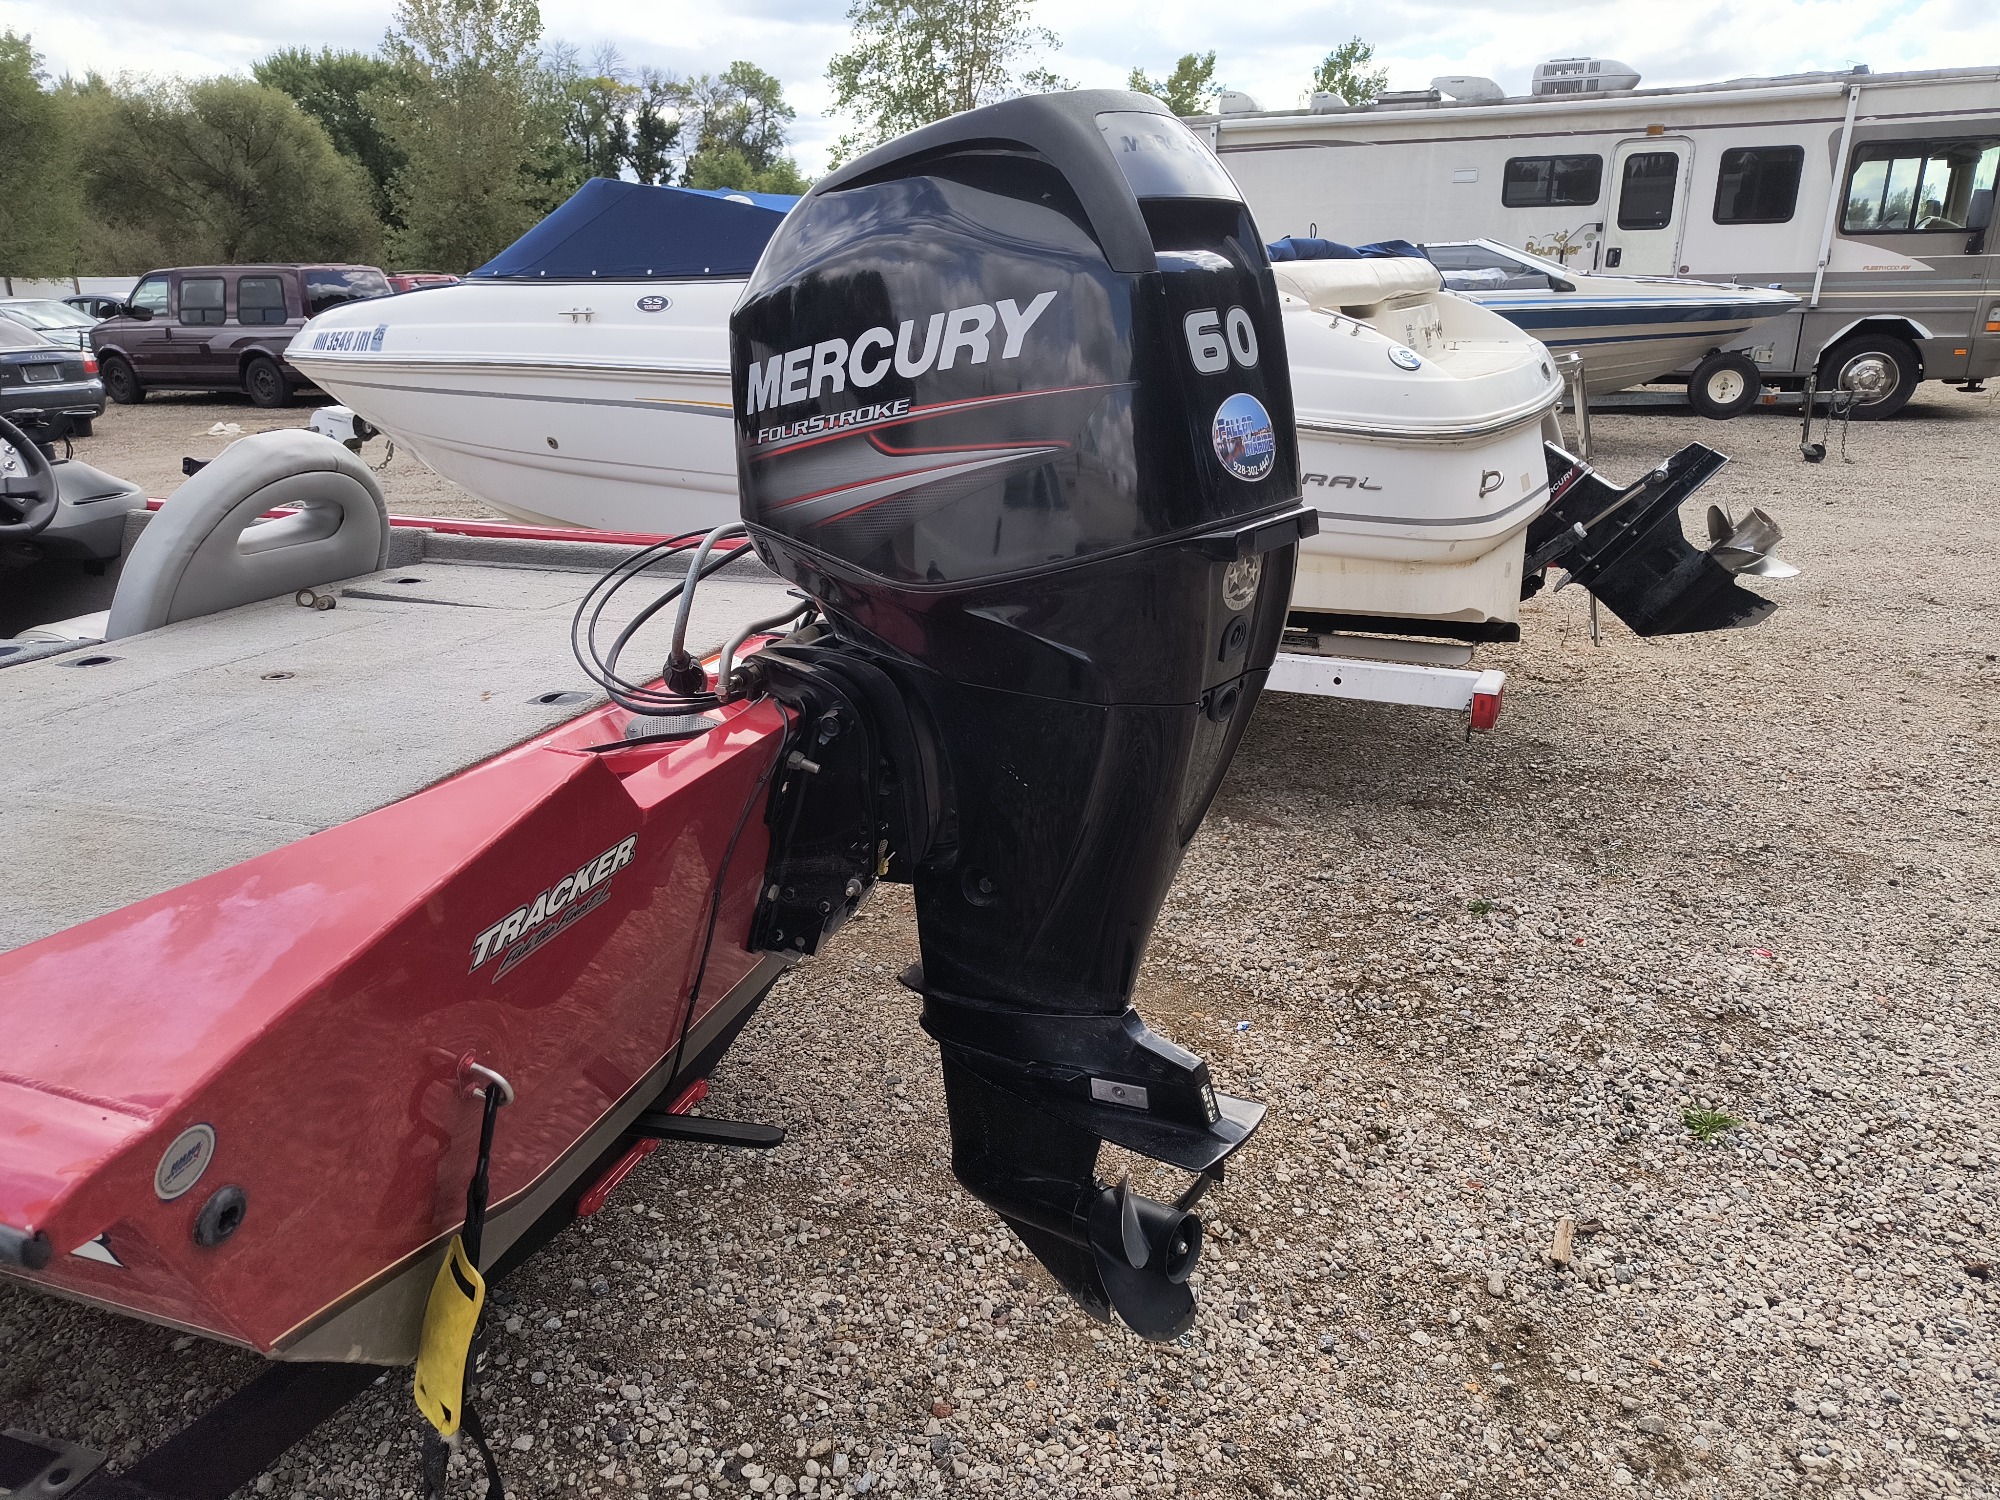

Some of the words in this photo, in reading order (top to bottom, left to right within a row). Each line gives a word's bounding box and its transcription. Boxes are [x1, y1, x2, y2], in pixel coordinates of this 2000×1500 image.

[642, 297, 663, 305] SS
[326, 331, 355, 352] 3548
[373, 327, 386, 341] 25
[1183, 304, 1259, 376] 60
[746, 290, 1058, 416] MERCURY
[757, 398, 911, 444] FOURSTROKE
[1301, 472, 1383, 491] RAL
[470, 835, 637, 971] TRACKER
